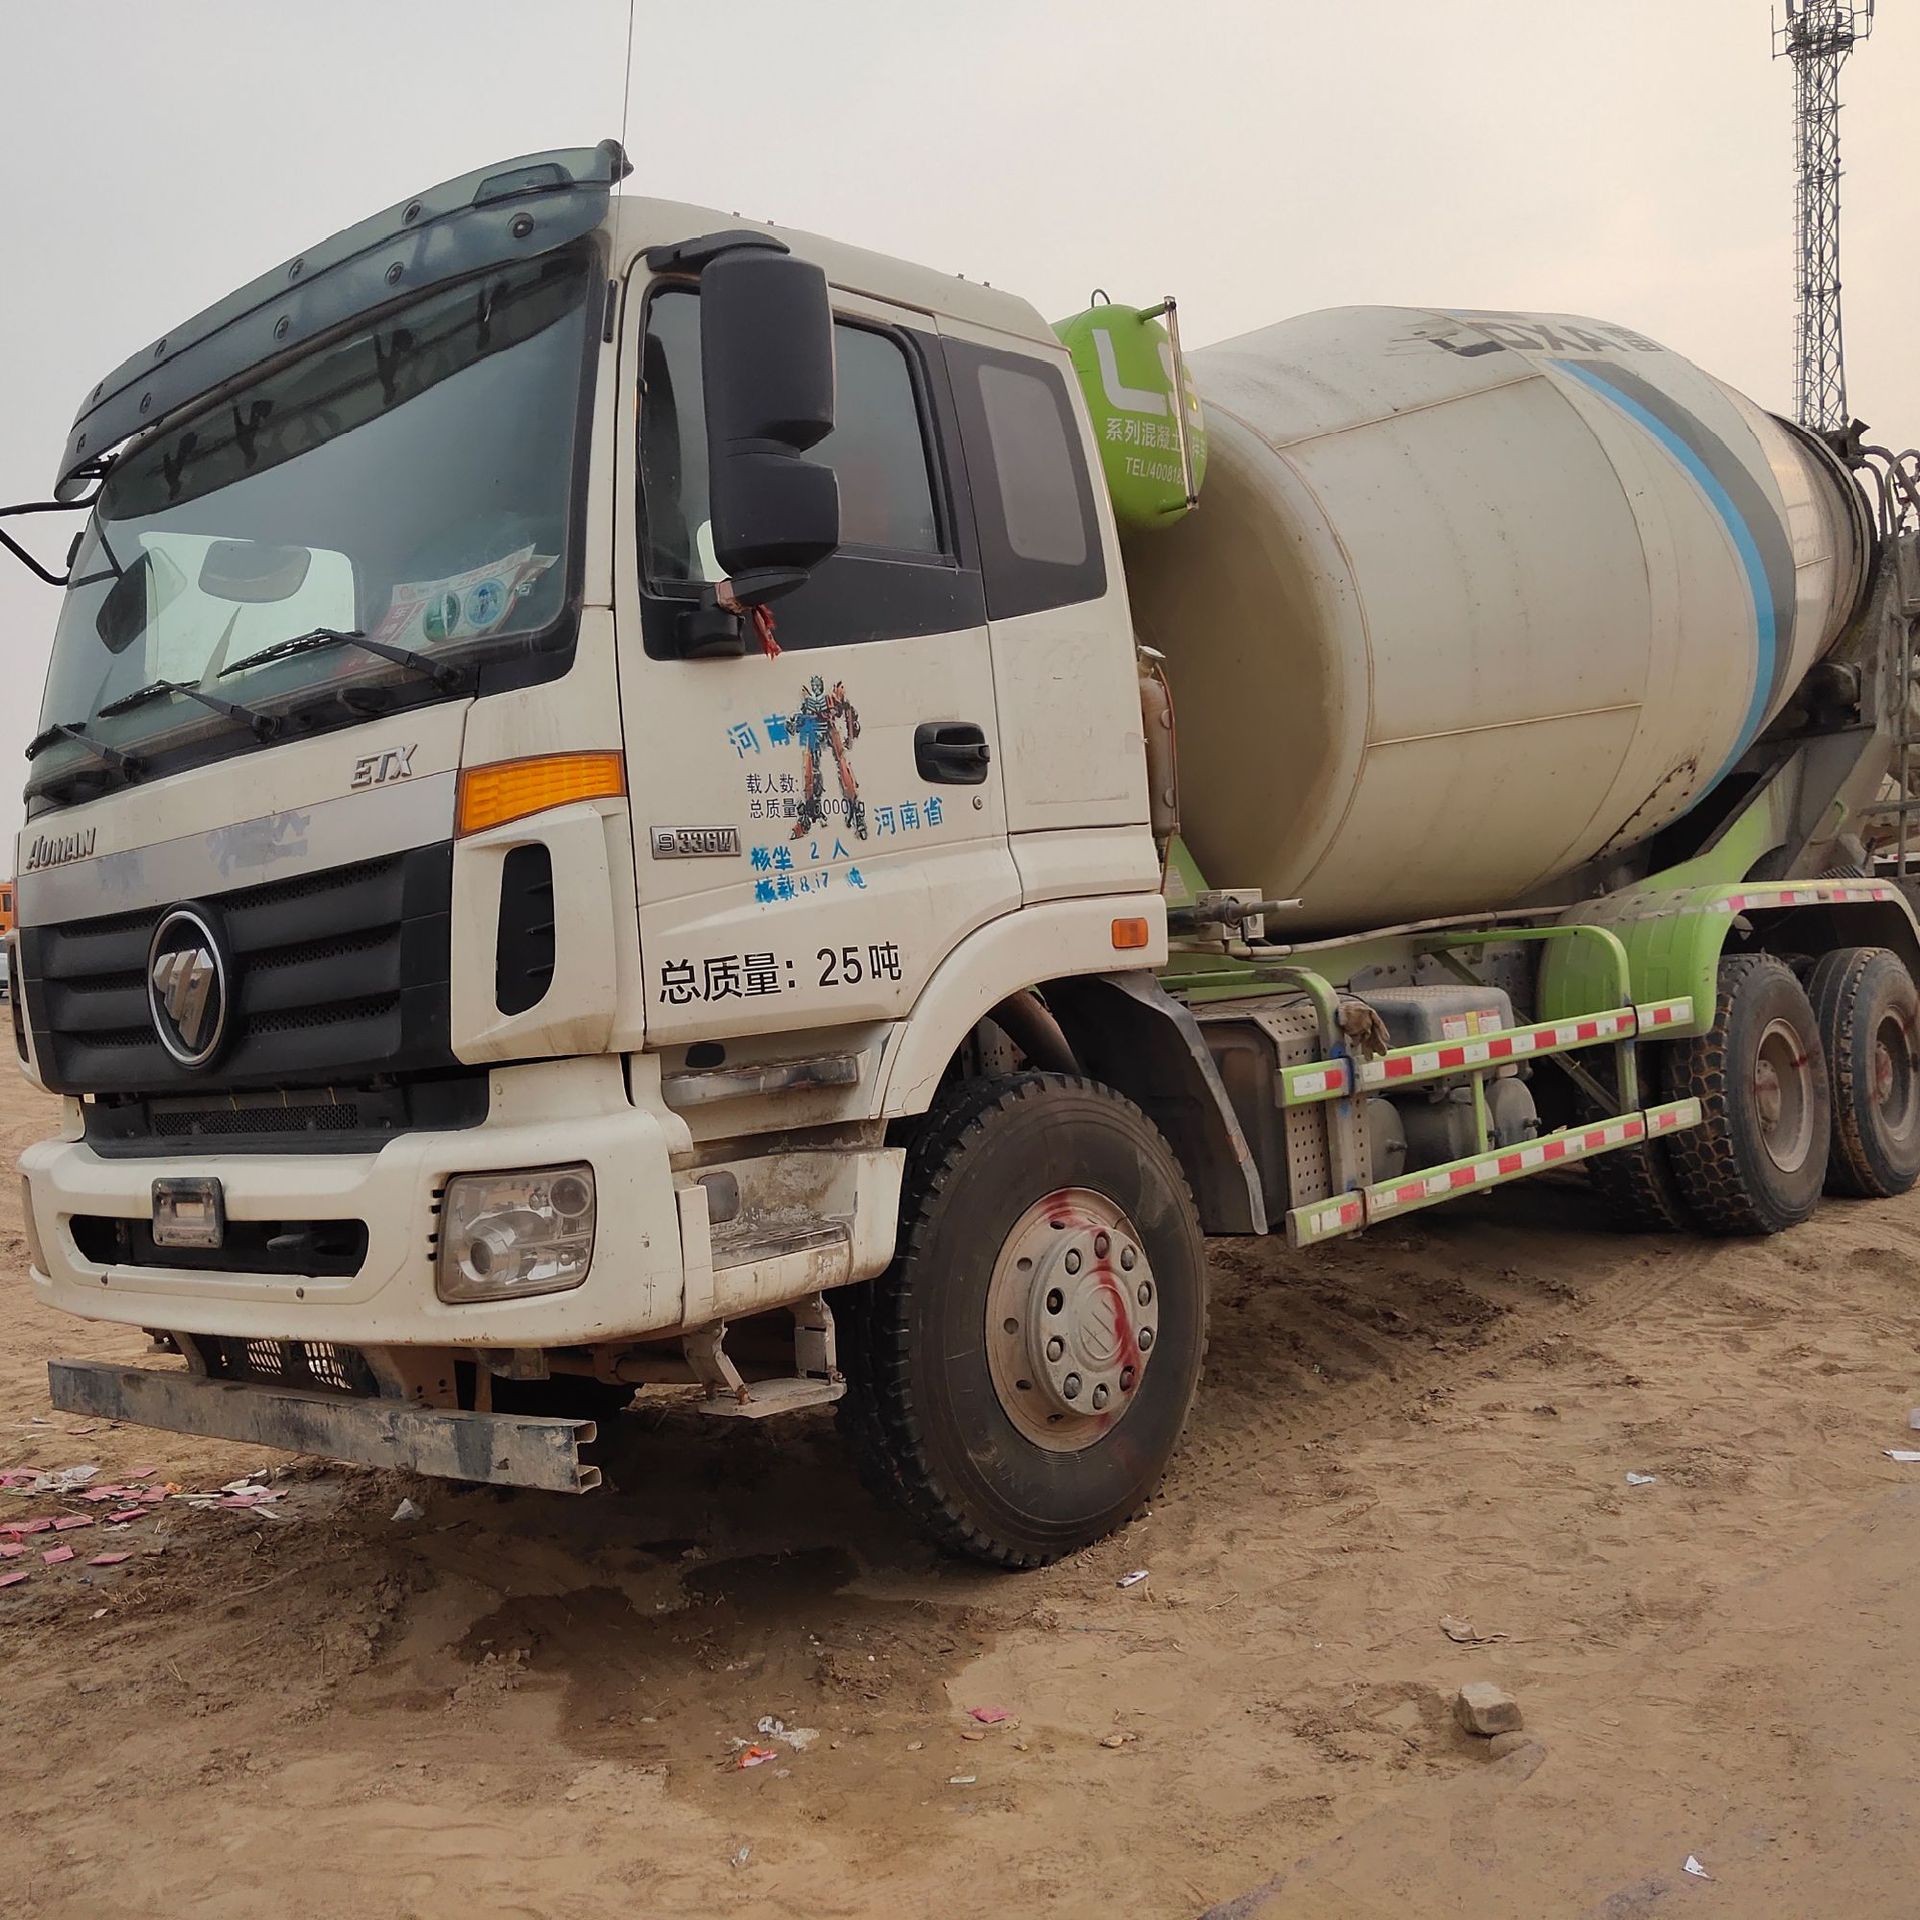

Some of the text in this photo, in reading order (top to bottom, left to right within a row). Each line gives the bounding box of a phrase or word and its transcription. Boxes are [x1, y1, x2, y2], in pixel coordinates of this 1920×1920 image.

[350, 744, 418, 788] ETX
[874, 796, 943, 836] 河南省
